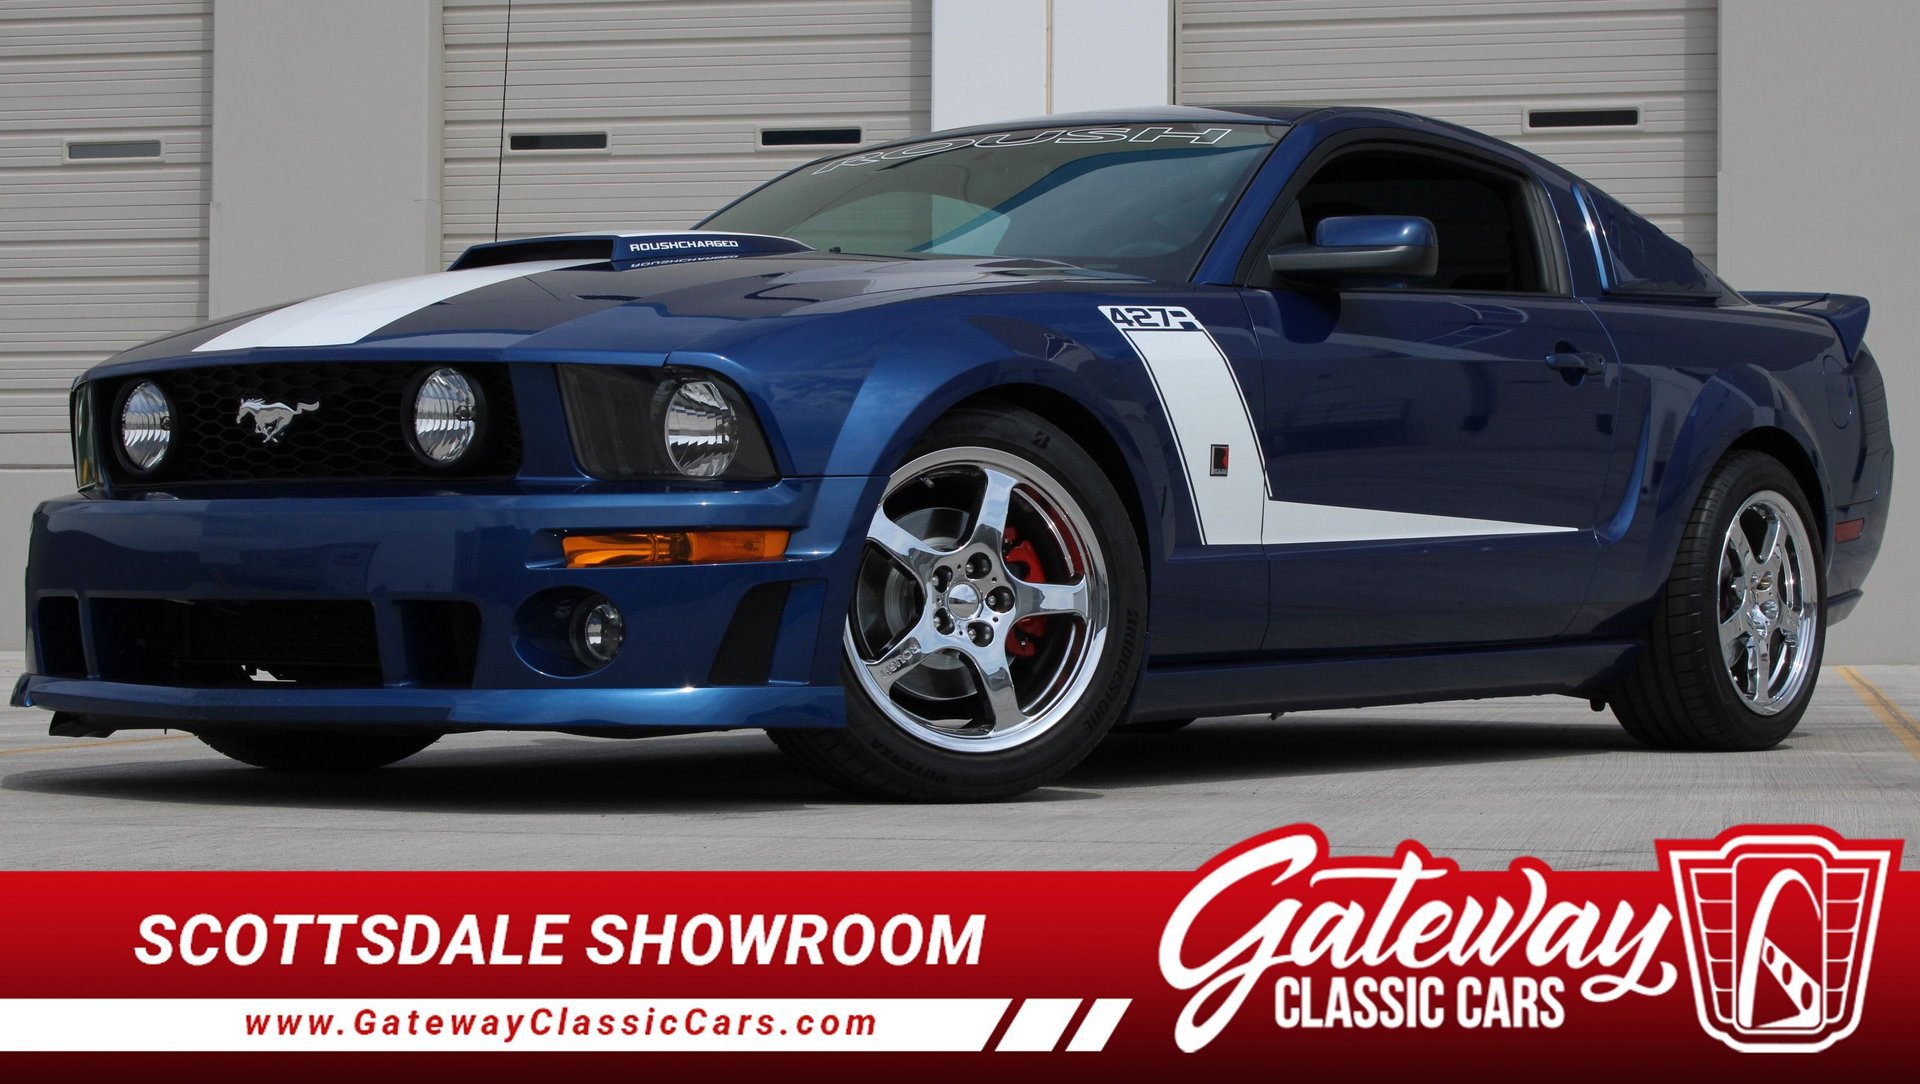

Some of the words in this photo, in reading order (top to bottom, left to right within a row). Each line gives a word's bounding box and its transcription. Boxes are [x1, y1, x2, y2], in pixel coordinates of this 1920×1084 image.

[811, 126, 1233, 175] ROUSH
[629, 240, 739, 252] ROUSHCHARGED
[1081, 607, 1140, 734] BRIDGESTONE
[870, 737, 950, 785] POTENZA
